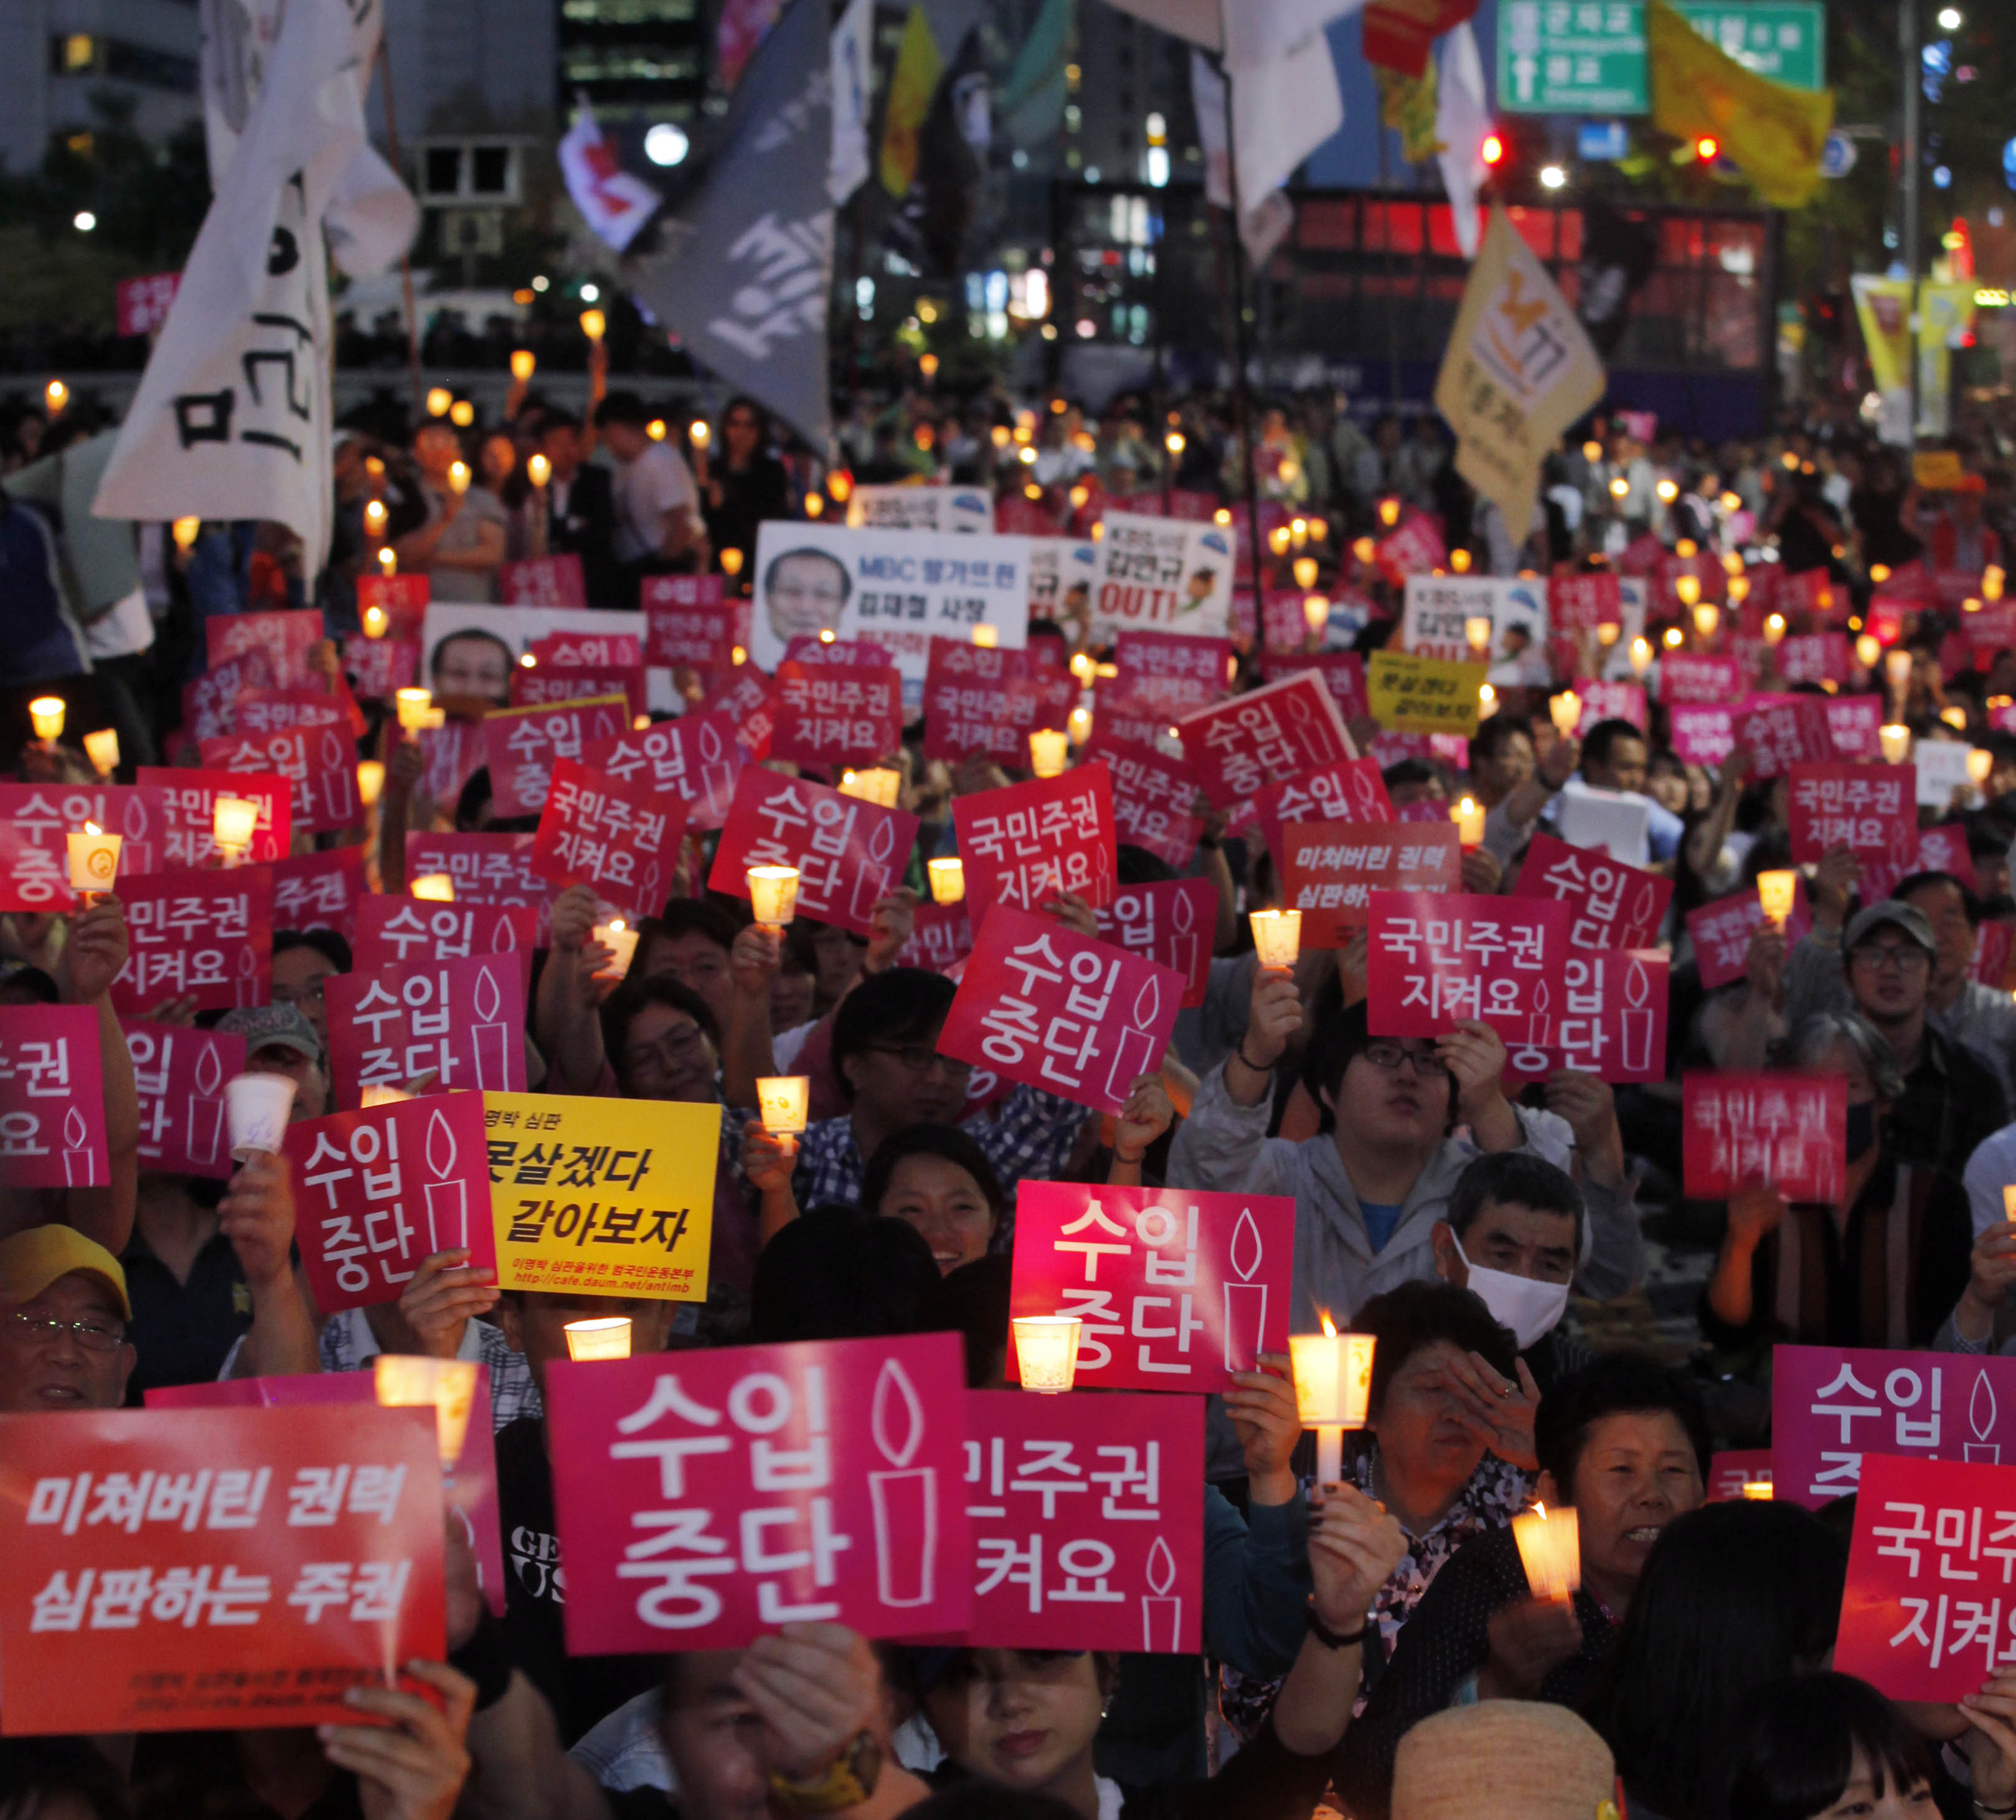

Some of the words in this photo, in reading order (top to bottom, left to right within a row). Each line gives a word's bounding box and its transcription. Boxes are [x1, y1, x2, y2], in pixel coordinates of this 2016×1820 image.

[1098, 582, 1177, 623] OUT!
[781, 677, 892, 716] 국민주권
[507, 712, 582, 762] 수입
[606, 727, 686, 781] 수입
[794, 717, 878, 751] 지켜요
[1206, 701, 1281, 753] 수입
[1222, 743, 1302, 794] 중단
[1276, 772, 1352, 823] 수입
[1794, 779, 1901, 814] 국민주권
[553, 781, 667, 853] 국민주권
[758, 785, 858, 857] 수입
[968, 789, 1100, 863] 국민주권
[1808, 816, 1885, 848] 지켜요
[553, 830, 635, 887] 지켜요
[997, 851, 1092, 911] 지켜요
[1295, 846, 1392, 870] 미쳐버린
[1295, 883, 1379, 910] 심판하
[1543, 854, 1627, 923] 수입
[126, 893, 248, 943] 민주권
[380, 905, 474, 962] 수입
[1379, 917, 1545, 971] 국민주권
[352, 968, 452, 1044] 수입
[1004, 932, 1122, 1024] 수입
[1401, 973, 1524, 1021] 지켜요
[1563, 956, 1605, 1015] 입
[0, 1037, 72, 1099] 권
[126, 1031, 174, 1096] 입
[980, 994, 1100, 1089] 중단
[524, 1112, 562, 1131] 심판
[303, 1116, 402, 1210] 수입
[486, 1139, 653, 1192] 못살겠다
[321, 1202, 416, 1293] 중단
[506, 1199, 690, 1253] 갈아보자
[1053, 1199, 1199, 1288] 수입
[512, 1257, 549, 1271] 이명박
[551, 1260, 609, 1276] 심판을위한
[611, 1265, 695, 1281] 범국민운동본부
[1055, 1288, 1205, 1375] 중단
[609, 1365, 833, 1500] 수입
[1810, 1362, 1944, 1448] 수입
[25, 1466, 273, 1536] 미쳐버린
[286, 1461, 408, 1528] 권력
[616, 1497, 852, 1630] 중단
[974, 1534, 1126, 1615] 켜요
[31, 1565, 271, 1633] 심판하는
[287, 1558, 413, 1625] 주권
